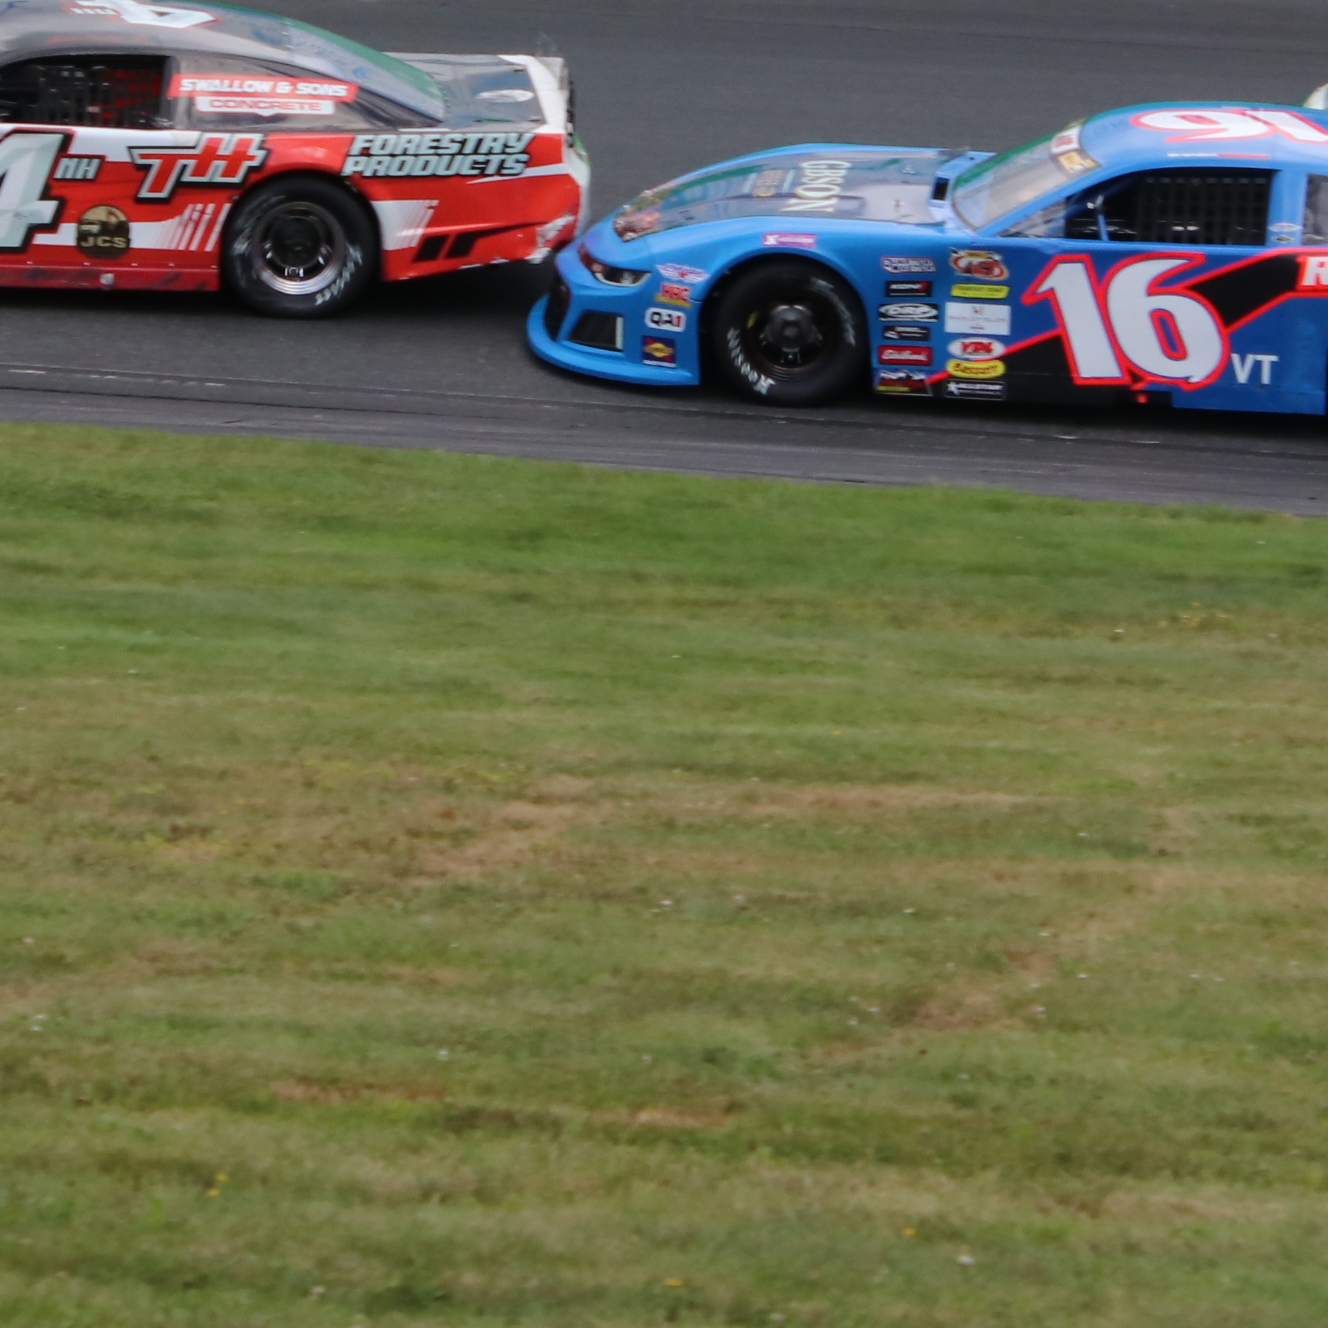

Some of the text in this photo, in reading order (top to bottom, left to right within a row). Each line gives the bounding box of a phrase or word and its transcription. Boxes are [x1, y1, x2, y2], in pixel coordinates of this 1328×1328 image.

[180, 78, 349, 98] SWALLOW & SONS
[209, 97, 324, 113] CONCRETE
[349, 133, 535, 156] FORESTRY
[342, 154, 530, 177] PRODUCTS
[81, 235, 128, 249] JCS
[649, 309, 683, 328] QA1
[1032, 255, 1225, 385] 16
[1232, 353, 1278, 385] VT
